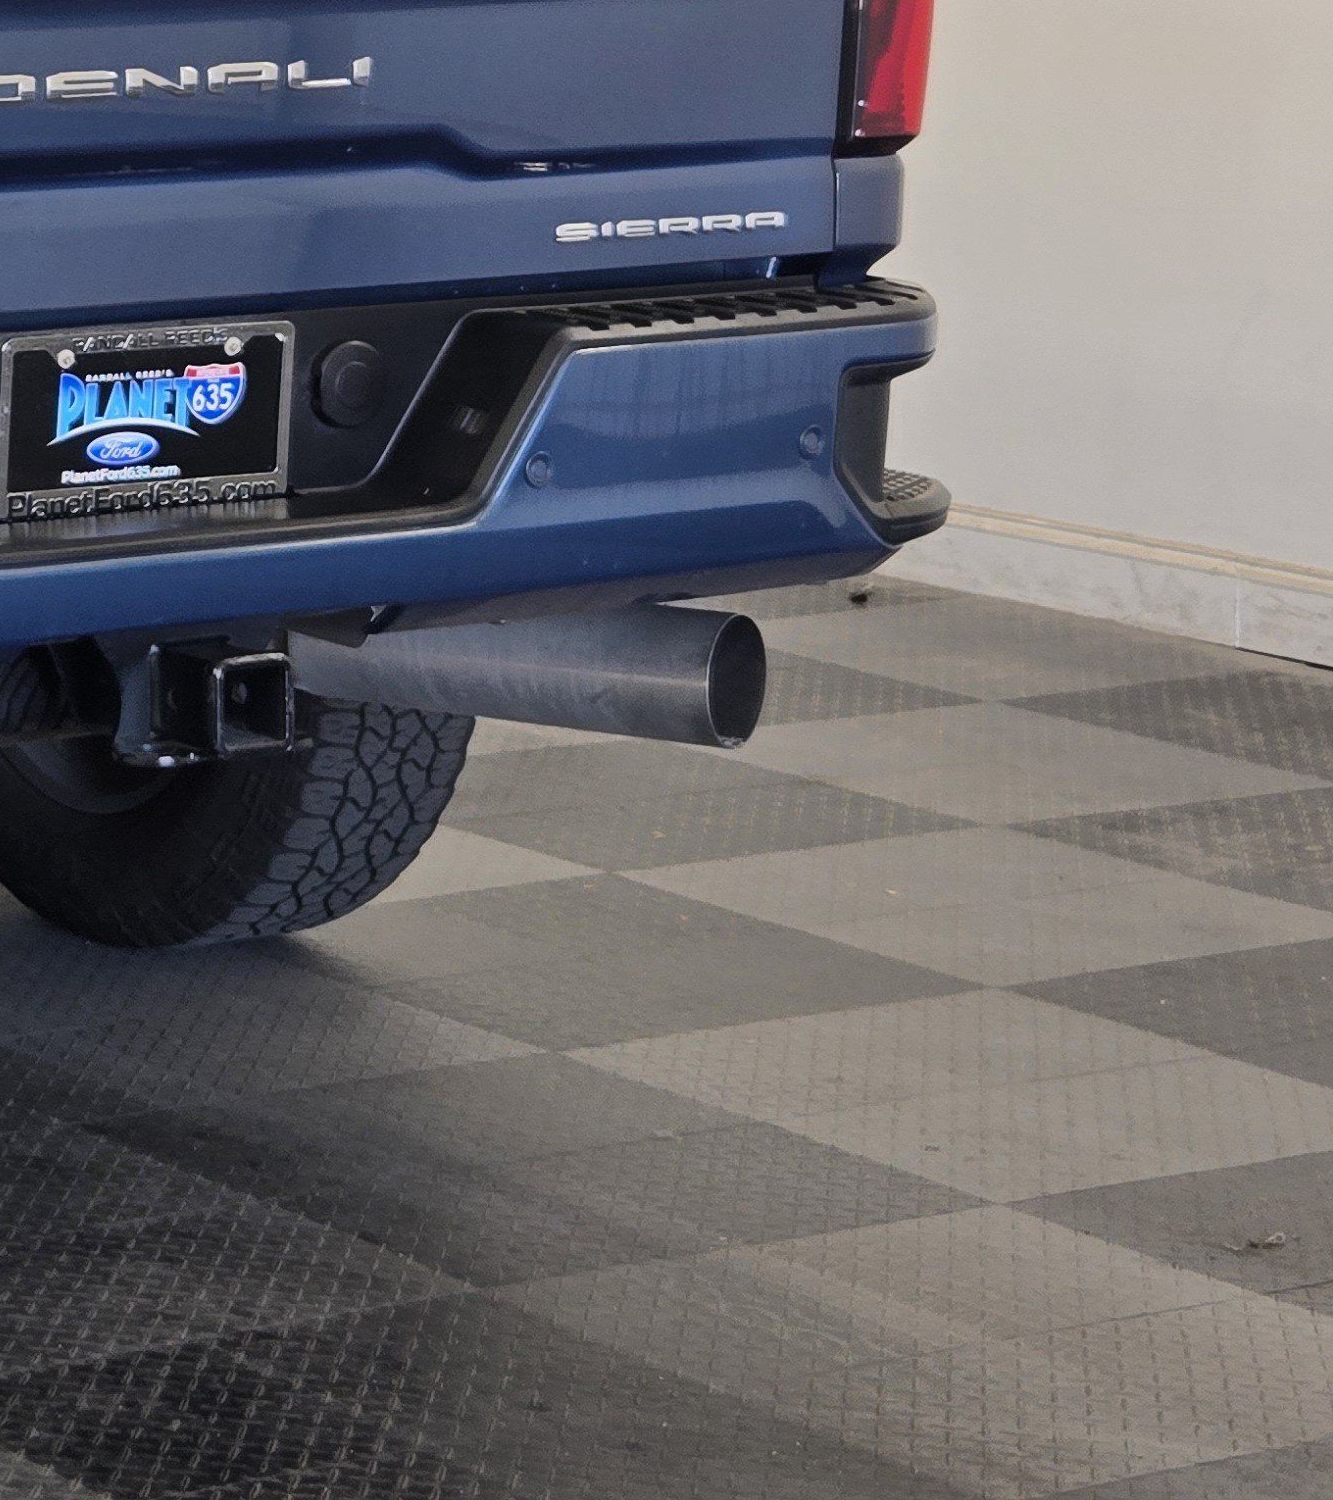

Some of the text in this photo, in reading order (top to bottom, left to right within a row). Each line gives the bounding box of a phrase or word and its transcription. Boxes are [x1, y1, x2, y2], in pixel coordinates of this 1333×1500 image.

[555, 210, 787, 243] SIERRA
[55, 372, 192, 439] PLANET
[193, 382, 234, 411] 635
[99, 437, 143, 459] Ford
[60, 464, 181, 485] PlanetFord635.com
[6, 478, 278, 518] PlanetFord635.com
